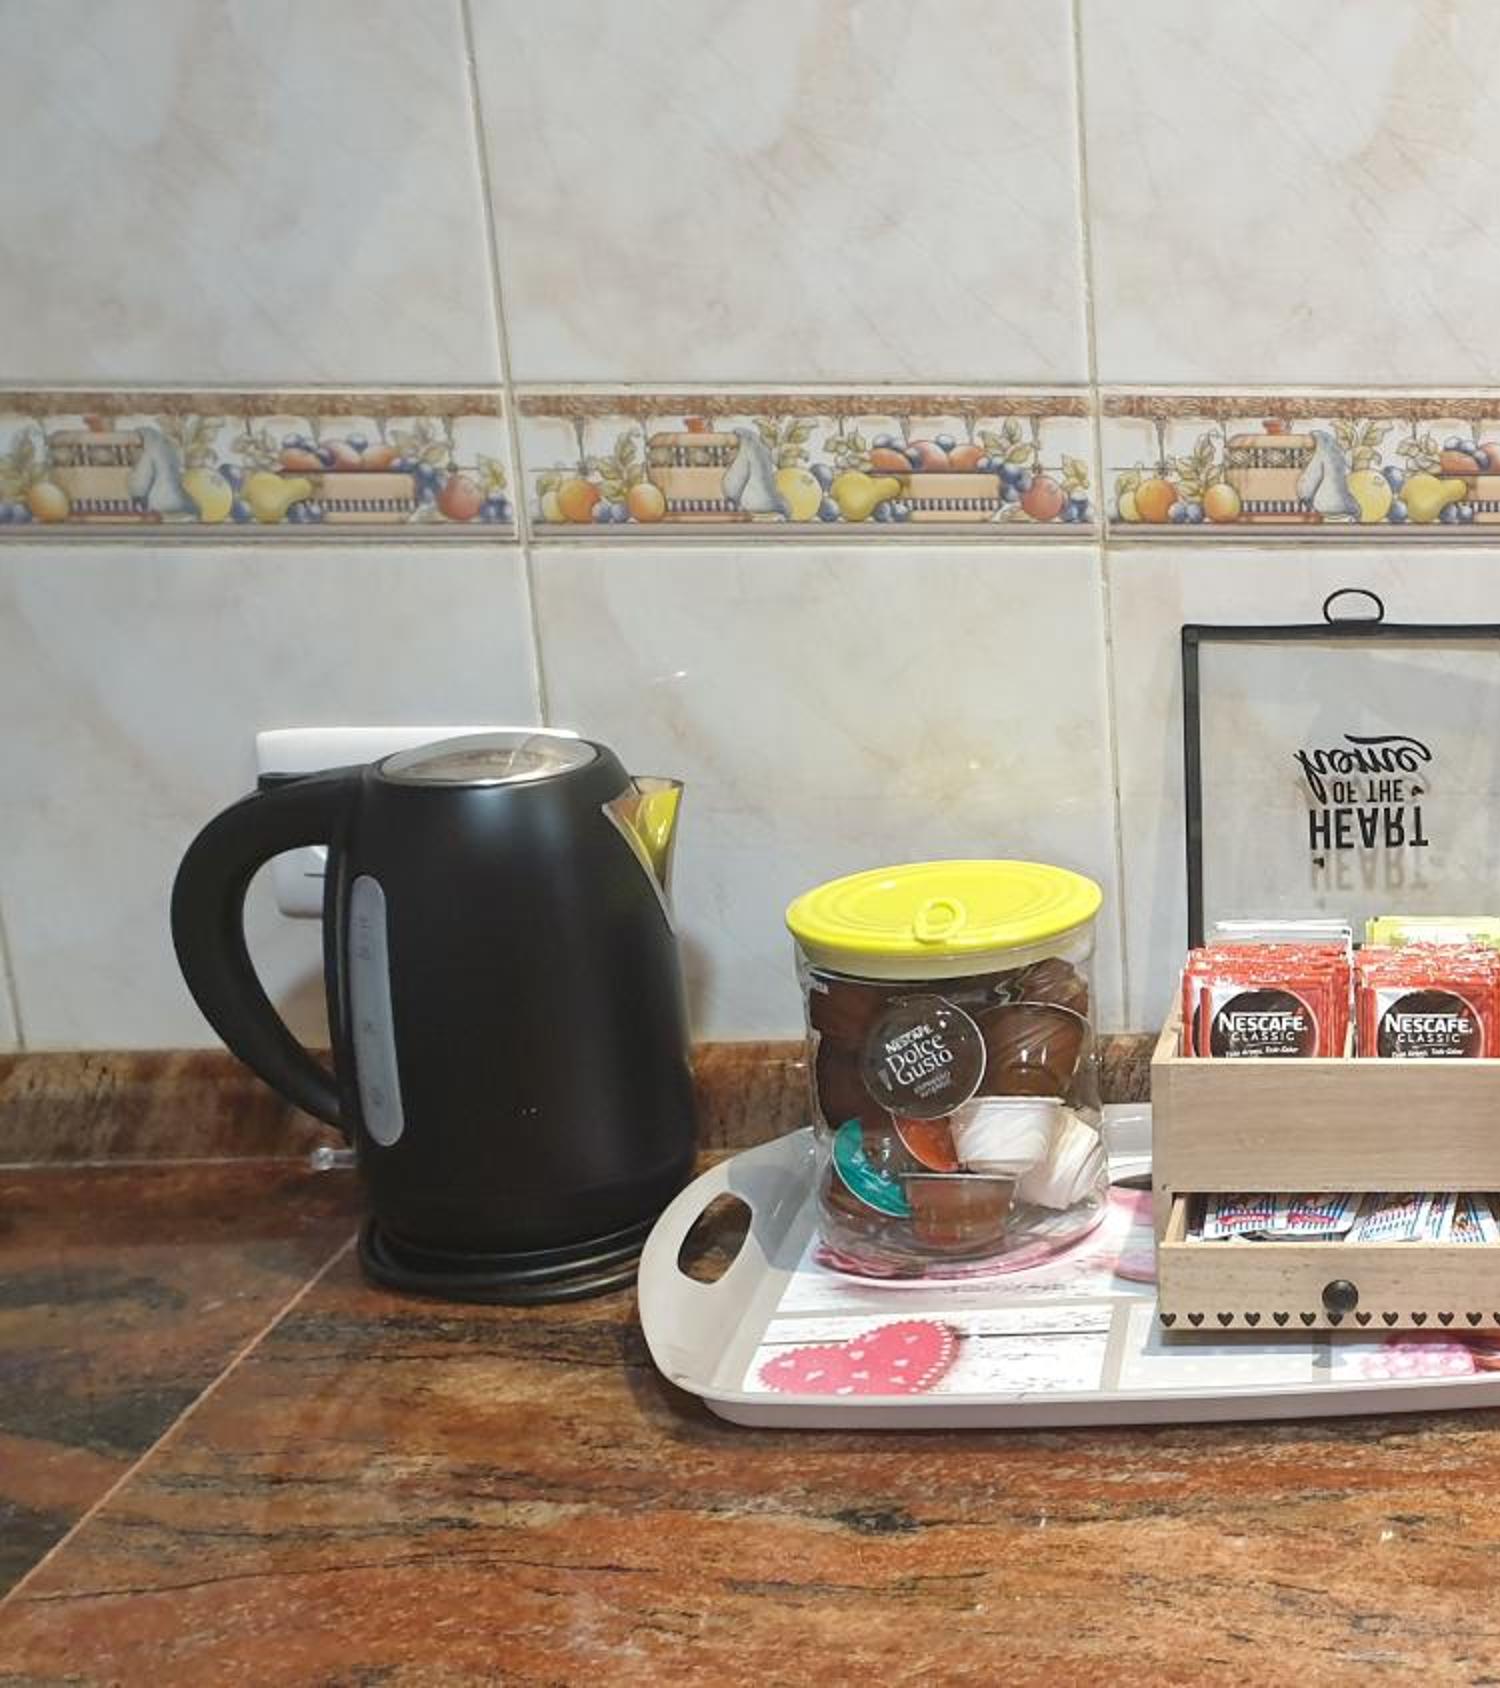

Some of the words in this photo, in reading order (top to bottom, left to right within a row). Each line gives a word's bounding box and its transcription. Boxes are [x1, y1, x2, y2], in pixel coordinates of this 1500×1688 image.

[1231, 1031, 1295, 1042] CLASSIC
[1397, 1033, 1461, 1043] CLASSIC
[886, 1035, 945, 1073] Dolce
[896, 1049, 954, 1085] Gusto
